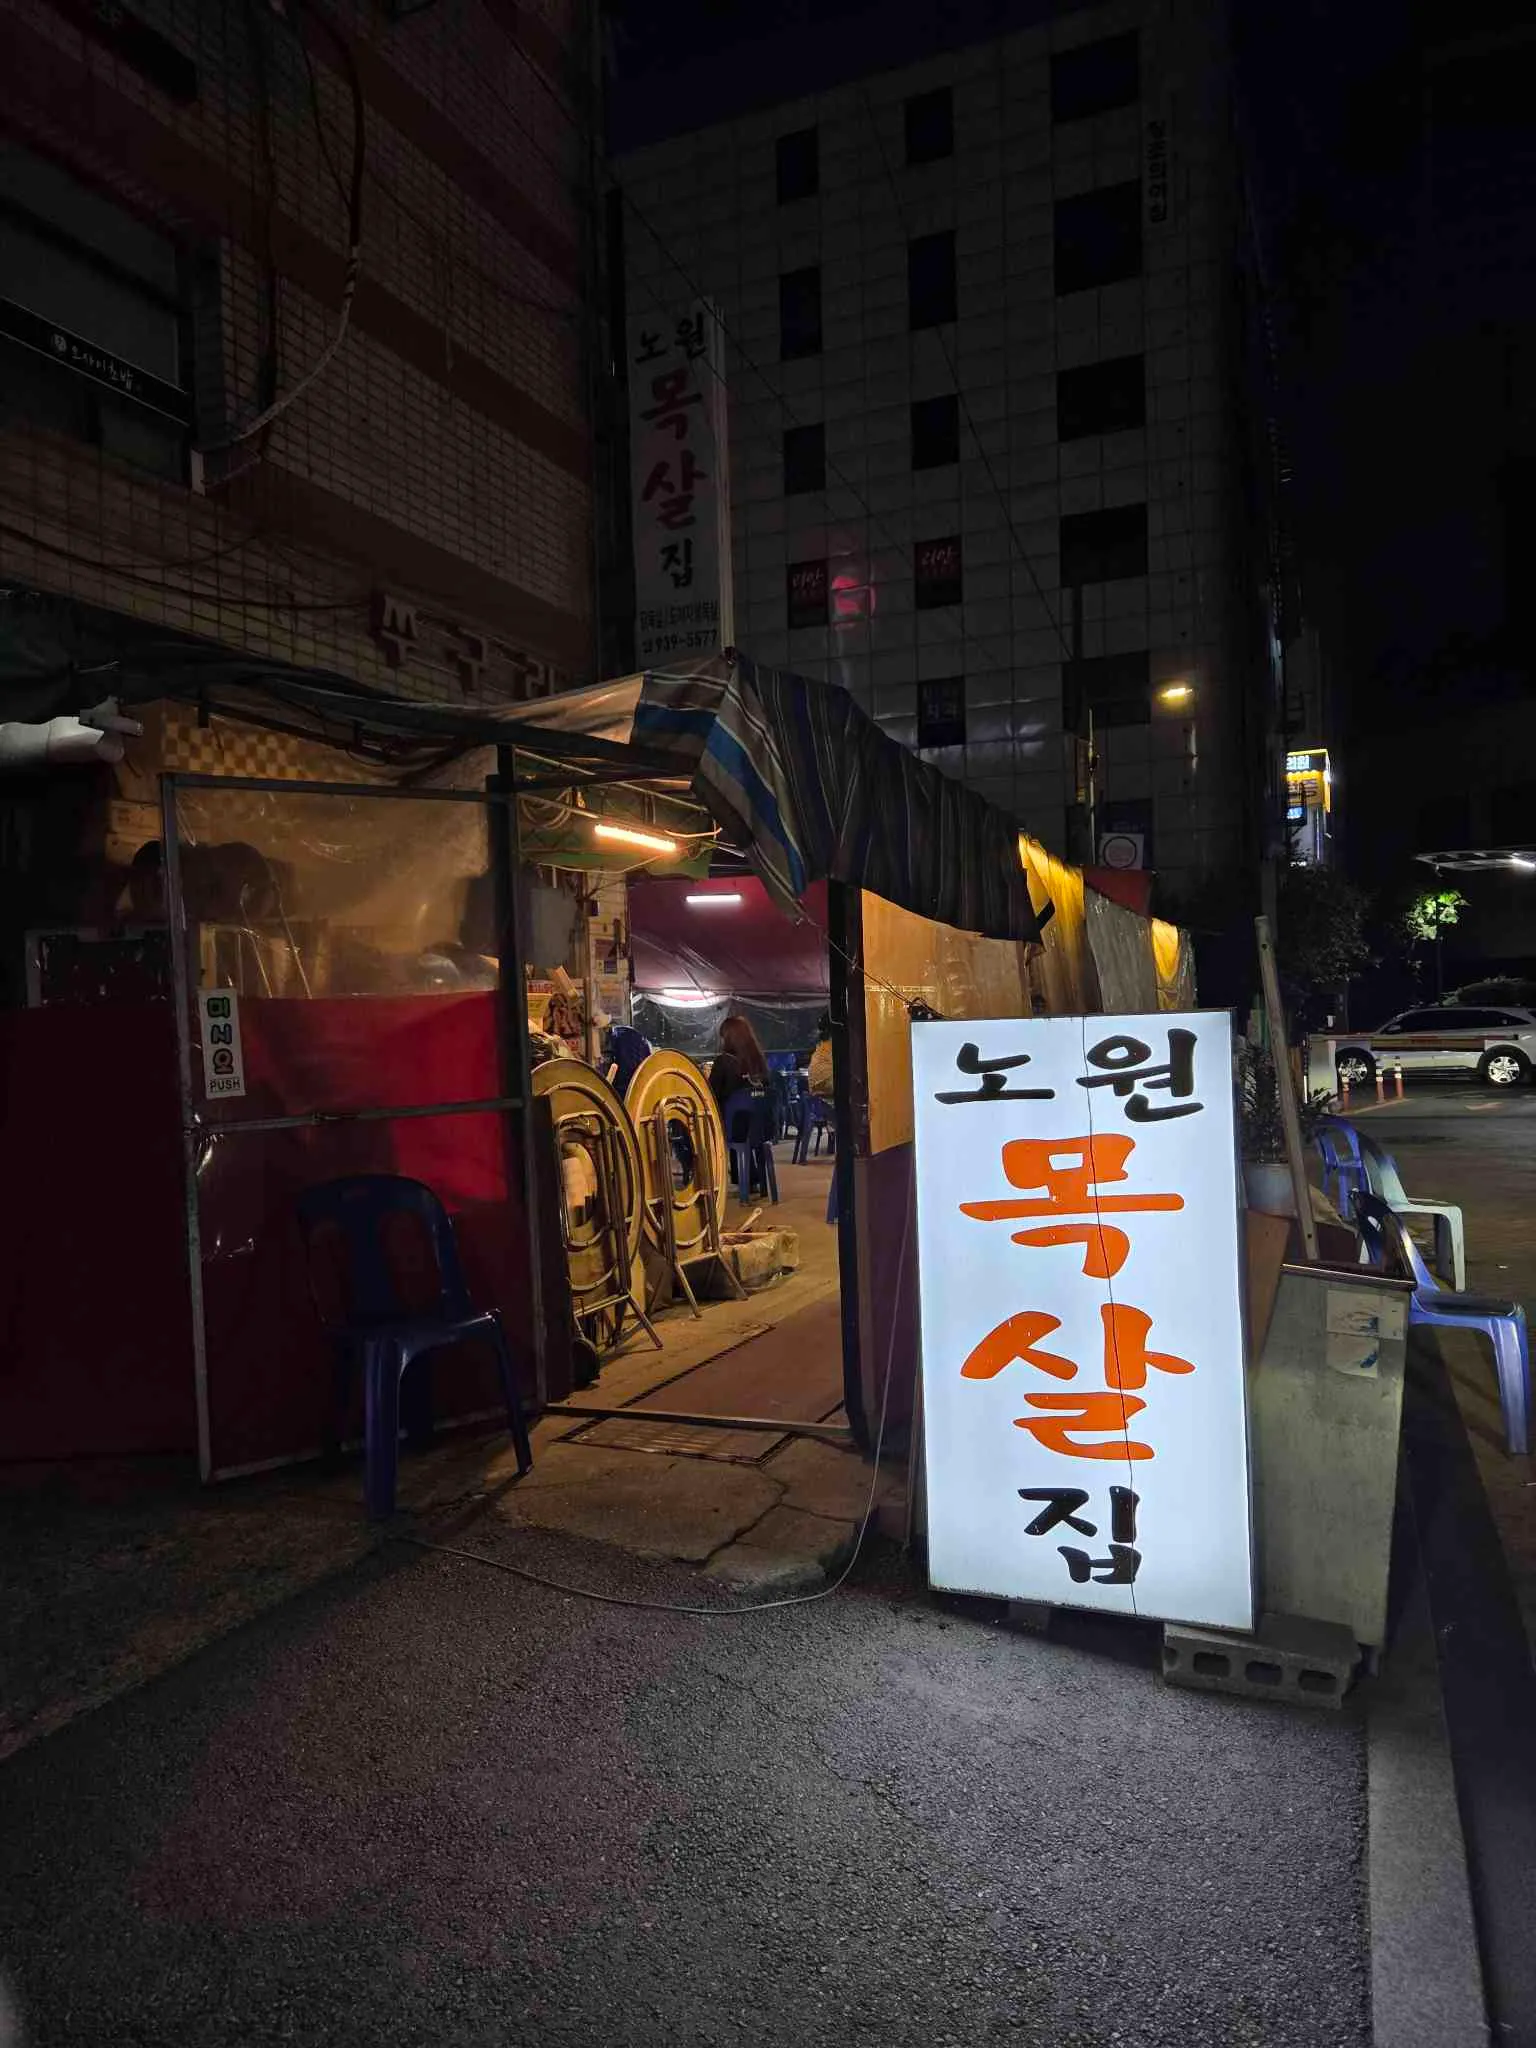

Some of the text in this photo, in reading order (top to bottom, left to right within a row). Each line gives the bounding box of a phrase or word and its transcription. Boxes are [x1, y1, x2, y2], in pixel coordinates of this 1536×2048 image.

[635, 313, 706, 363] 노원
[640, 368, 707, 588] 목살집
[207, 997, 234, 1074] 미시오
[934, 1028, 1204, 1122] 노원
[210, 1079, 241, 1092] PUSH
[959, 1133, 1196, 1584] 목살집
